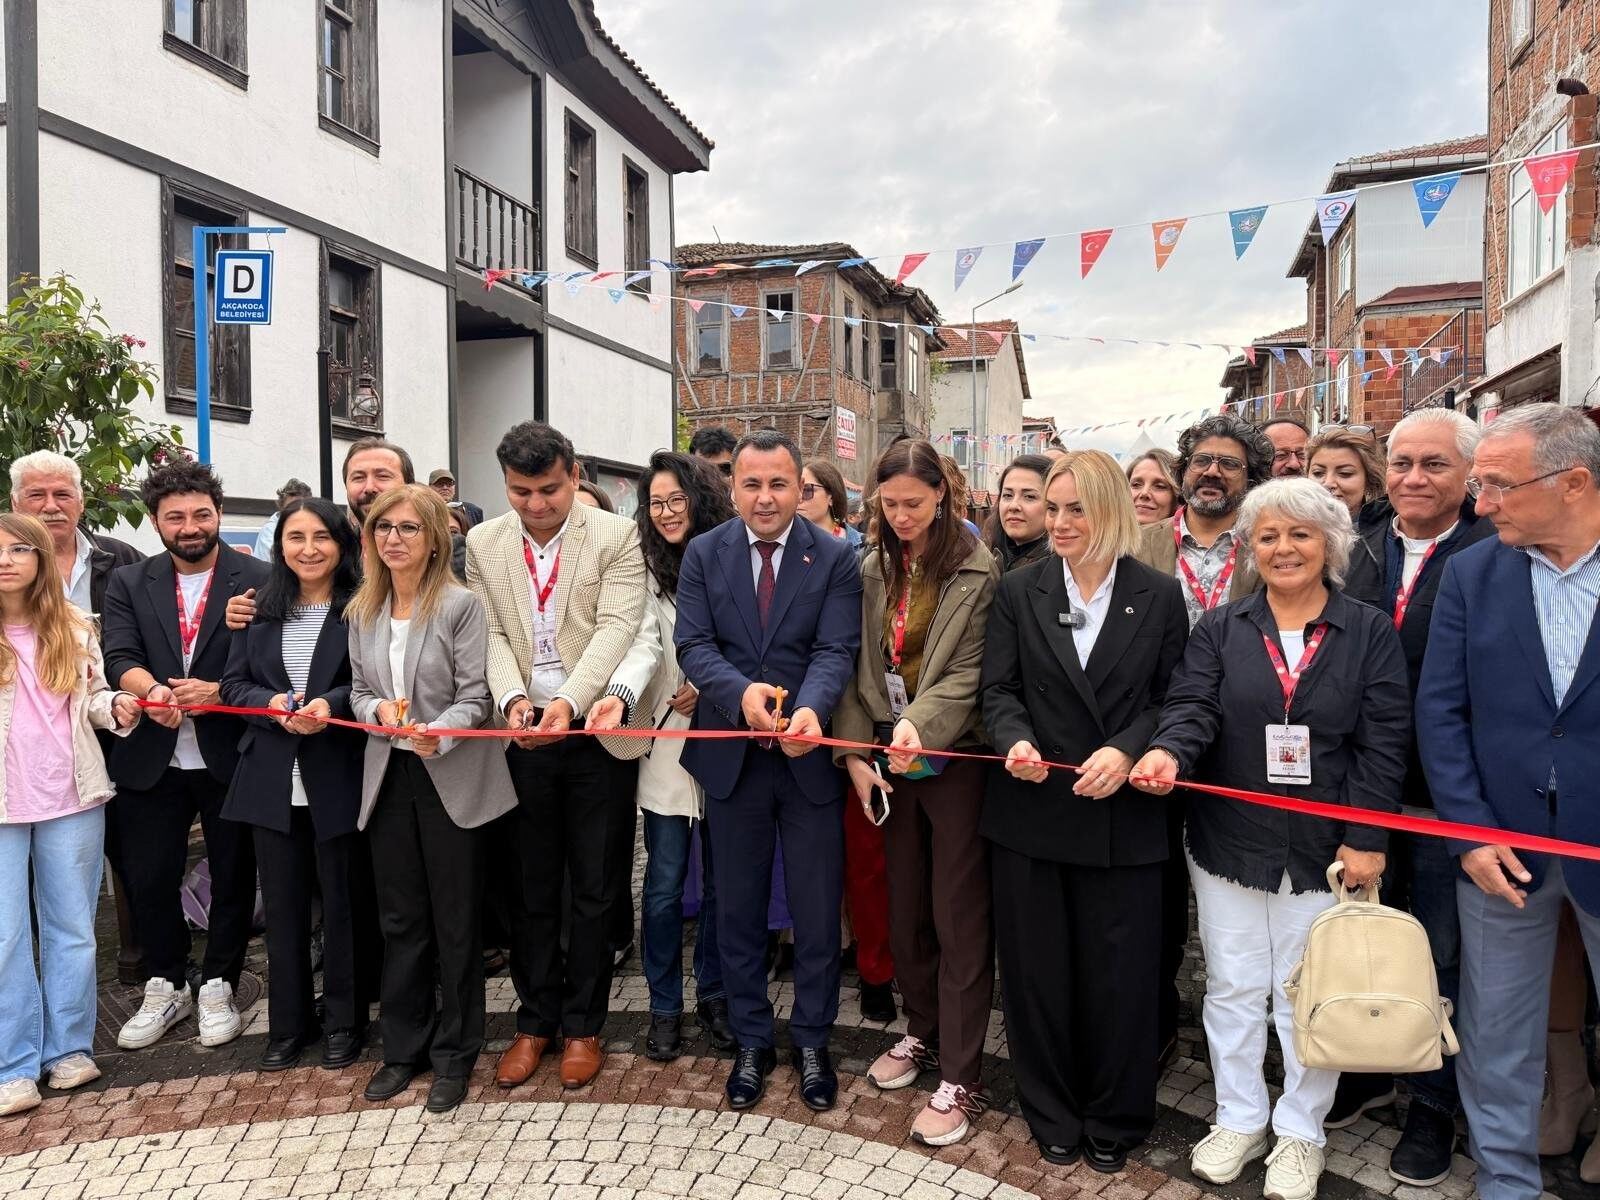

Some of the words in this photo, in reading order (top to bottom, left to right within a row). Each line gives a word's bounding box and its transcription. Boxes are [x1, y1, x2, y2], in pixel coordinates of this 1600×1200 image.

[233, 265, 254, 293] D
[221, 303, 264, 311] AKÇAKOCA
[220, 310, 264, 318] BELEDİYESİ
